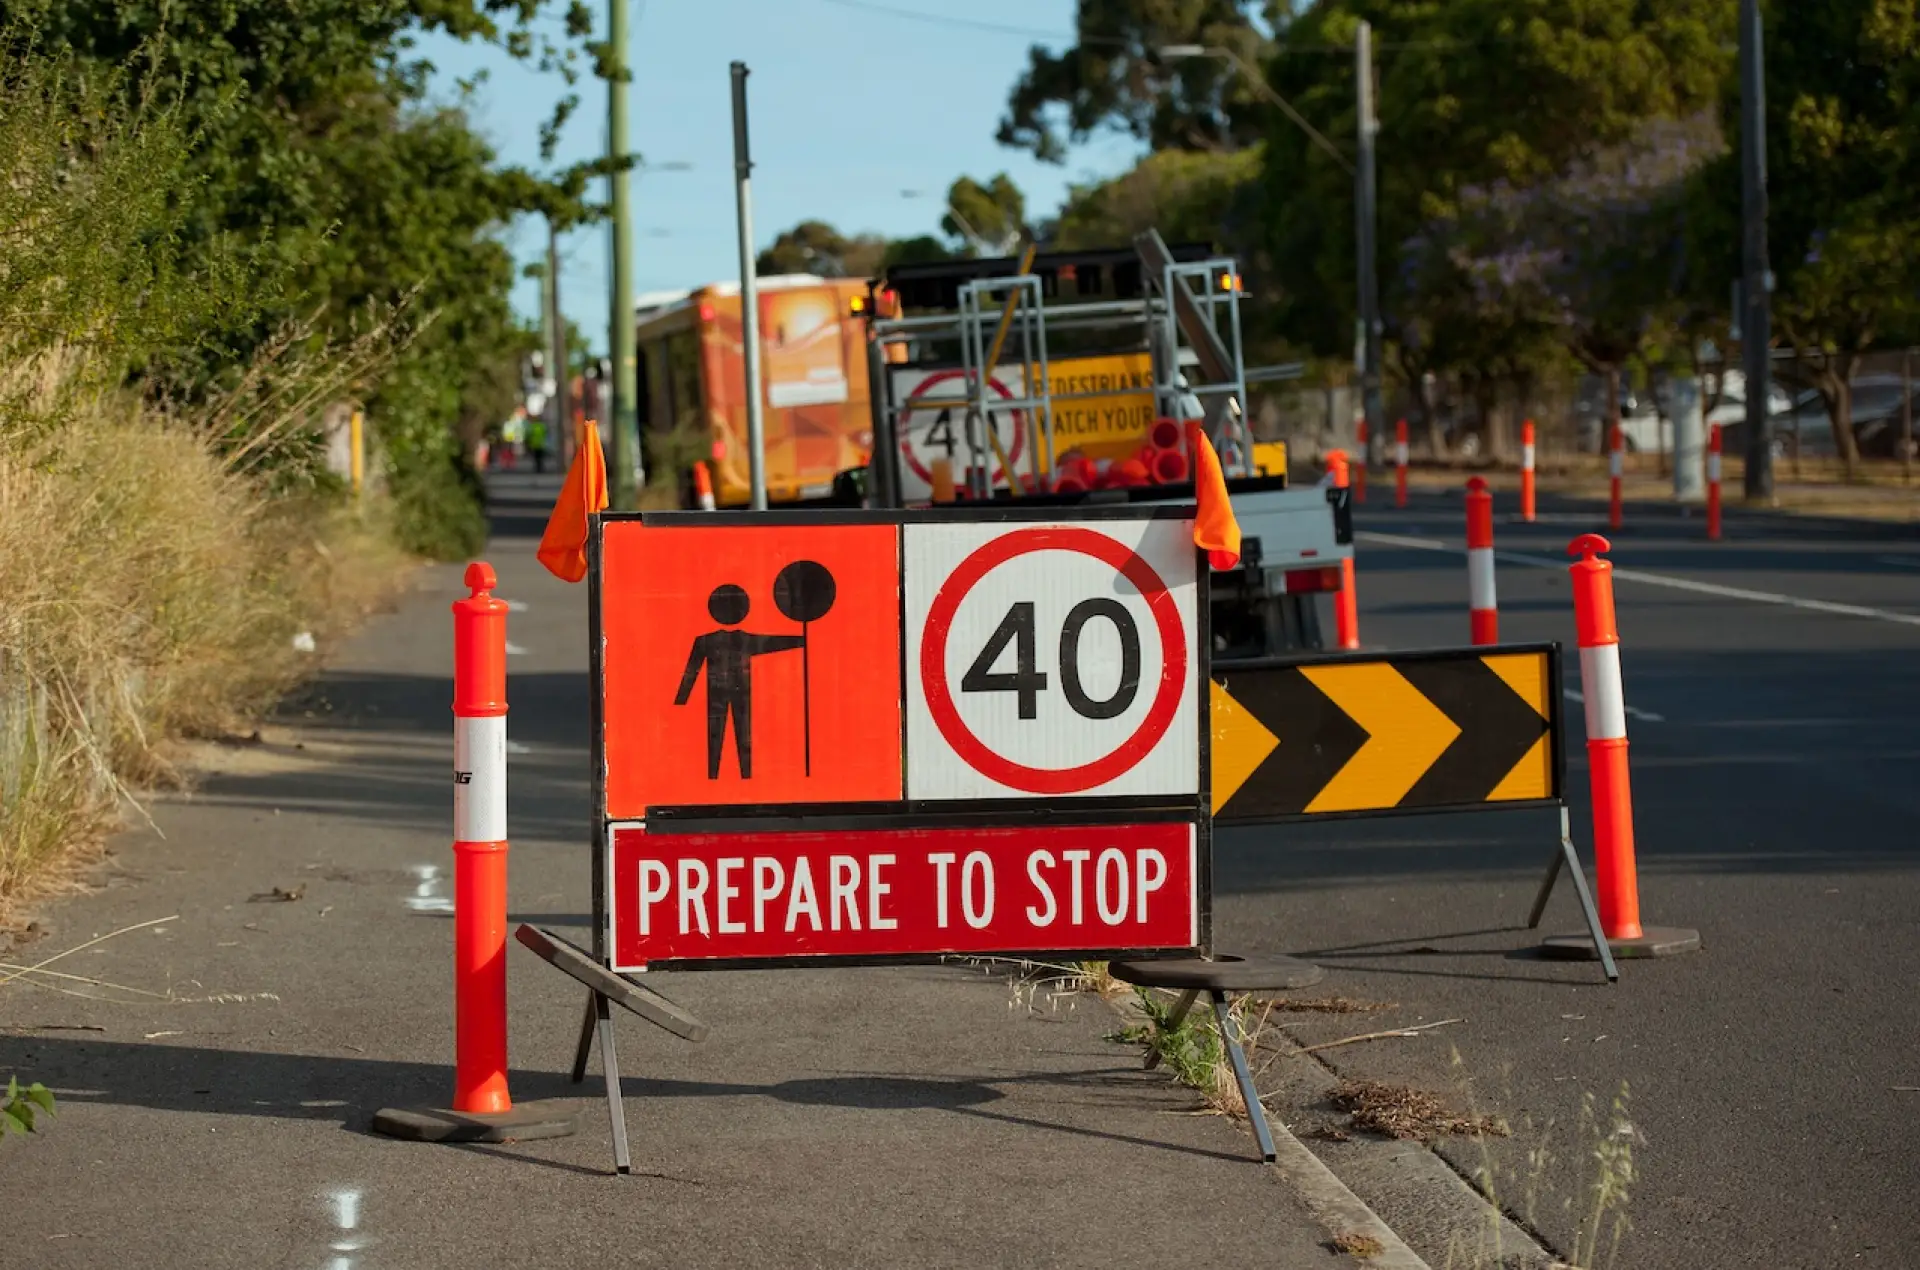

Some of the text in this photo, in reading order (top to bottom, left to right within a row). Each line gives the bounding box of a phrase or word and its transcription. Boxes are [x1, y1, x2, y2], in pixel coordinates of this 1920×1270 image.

[961, 597, 1141, 720] 40
[638, 847, 1168, 938] PREPARE TO STOP
